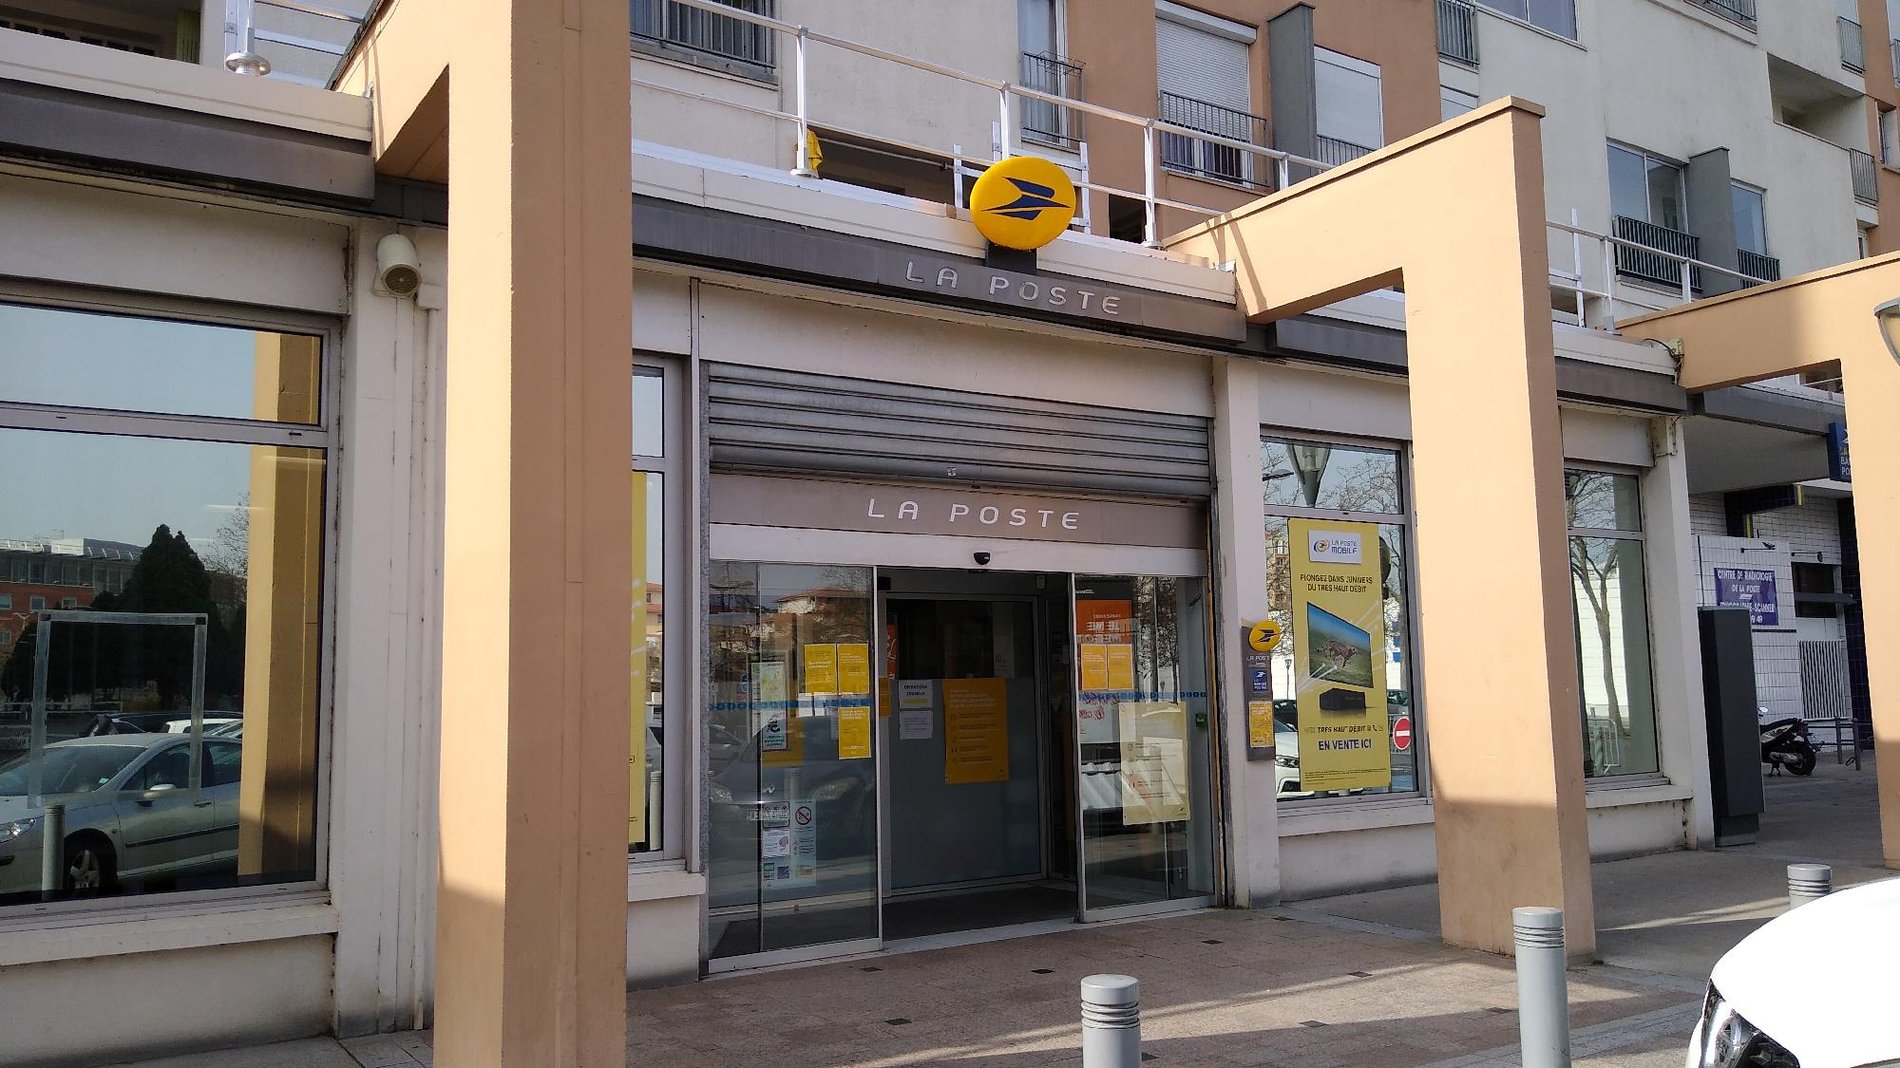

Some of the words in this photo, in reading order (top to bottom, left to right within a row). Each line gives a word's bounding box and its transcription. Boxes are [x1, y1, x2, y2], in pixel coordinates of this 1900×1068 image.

[904, 260, 959, 289] LA
[988, 275, 1121, 316] POSTE
[867, 498, 920, 520] LA
[949, 503, 1080, 530] POSTE
[1328, 574, 1345, 583] DANS
[1717, 570, 1736, 580] CENTRE
[1307, 583, 1317, 592] DU
[1333, 584, 1349, 592] HAUT
[1738, 584, 1745, 593] LA
[1318, 740, 1330, 751] EN
[1332, 739, 1360, 750] VENTE
[1361, 738, 1372, 749] ICI
